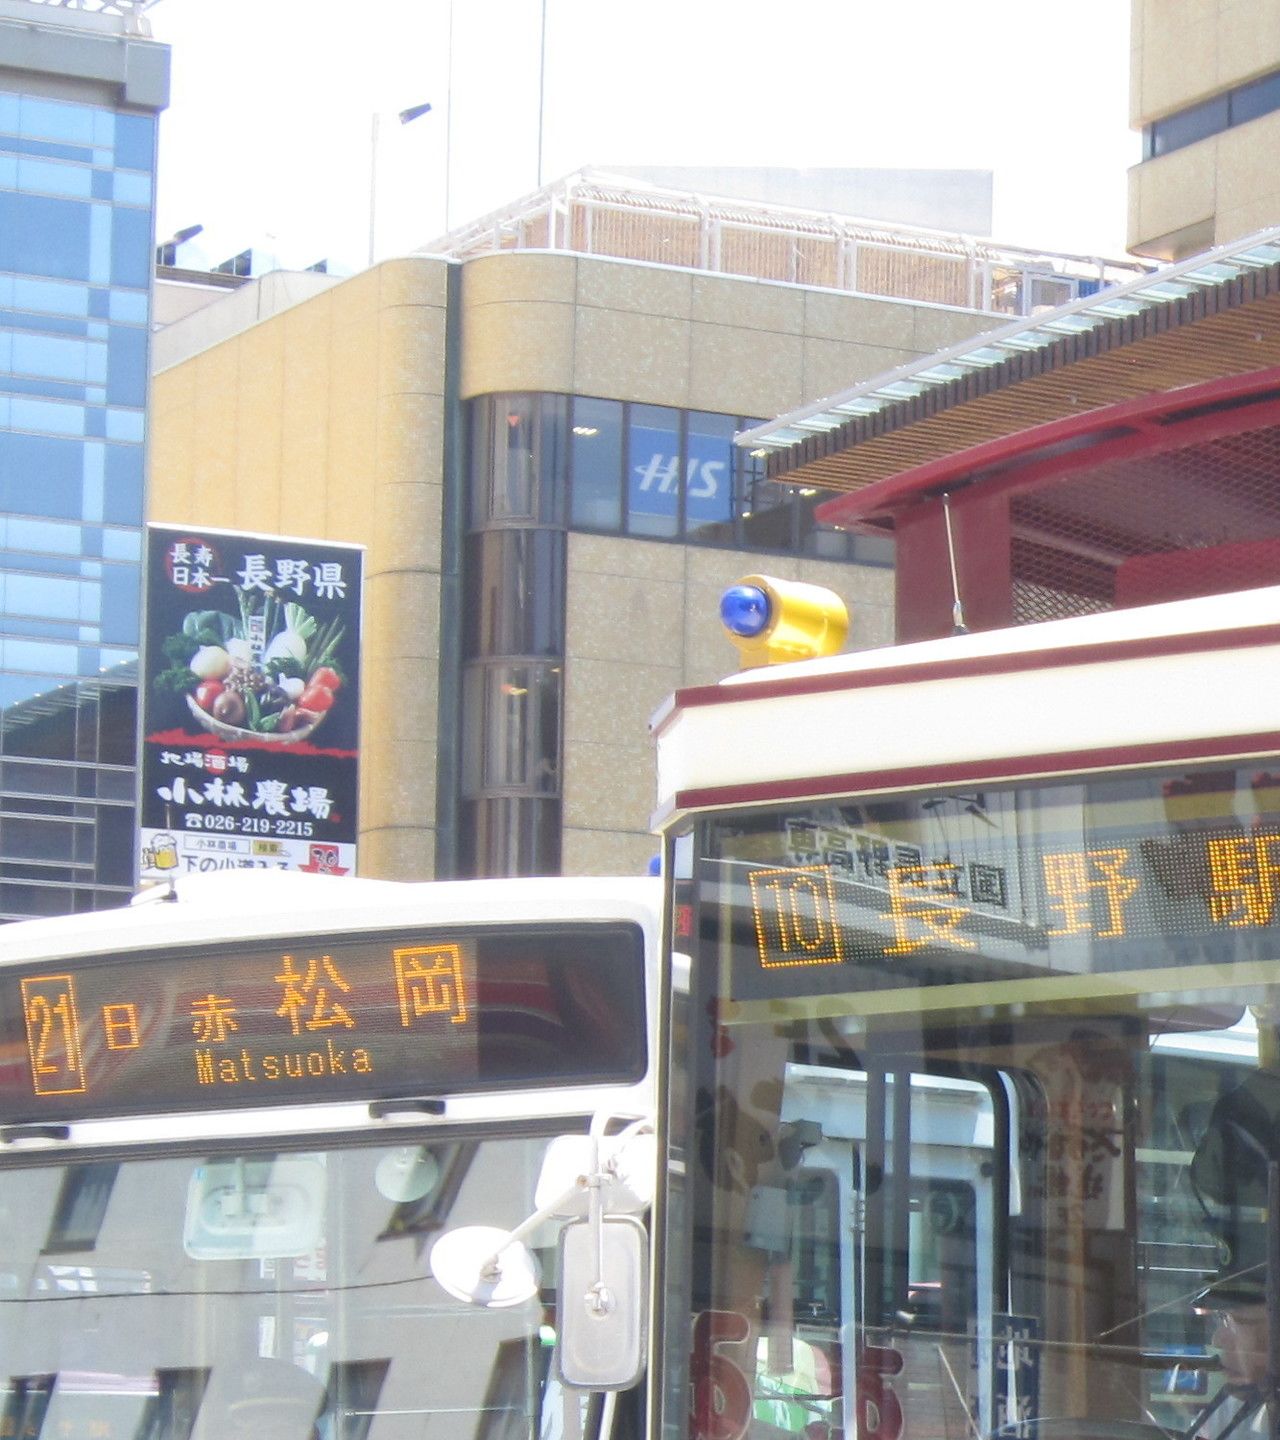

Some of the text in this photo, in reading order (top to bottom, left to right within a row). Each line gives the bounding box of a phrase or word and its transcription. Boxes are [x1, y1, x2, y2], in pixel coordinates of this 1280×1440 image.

[169, 542, 214, 568] 長寿
[236, 553, 348, 600] 長野県
[172, 566, 231, 589] 日本一
[156, 776, 336, 820] 小林農場
[204, 813, 314, 837] 026-219-2215
[765, 876, 824, 952] 10
[29, 993, 77, 1074] 21
[274, 943, 468, 1036] 松岡
[195, 1040, 373, 1085] Matsuoka
